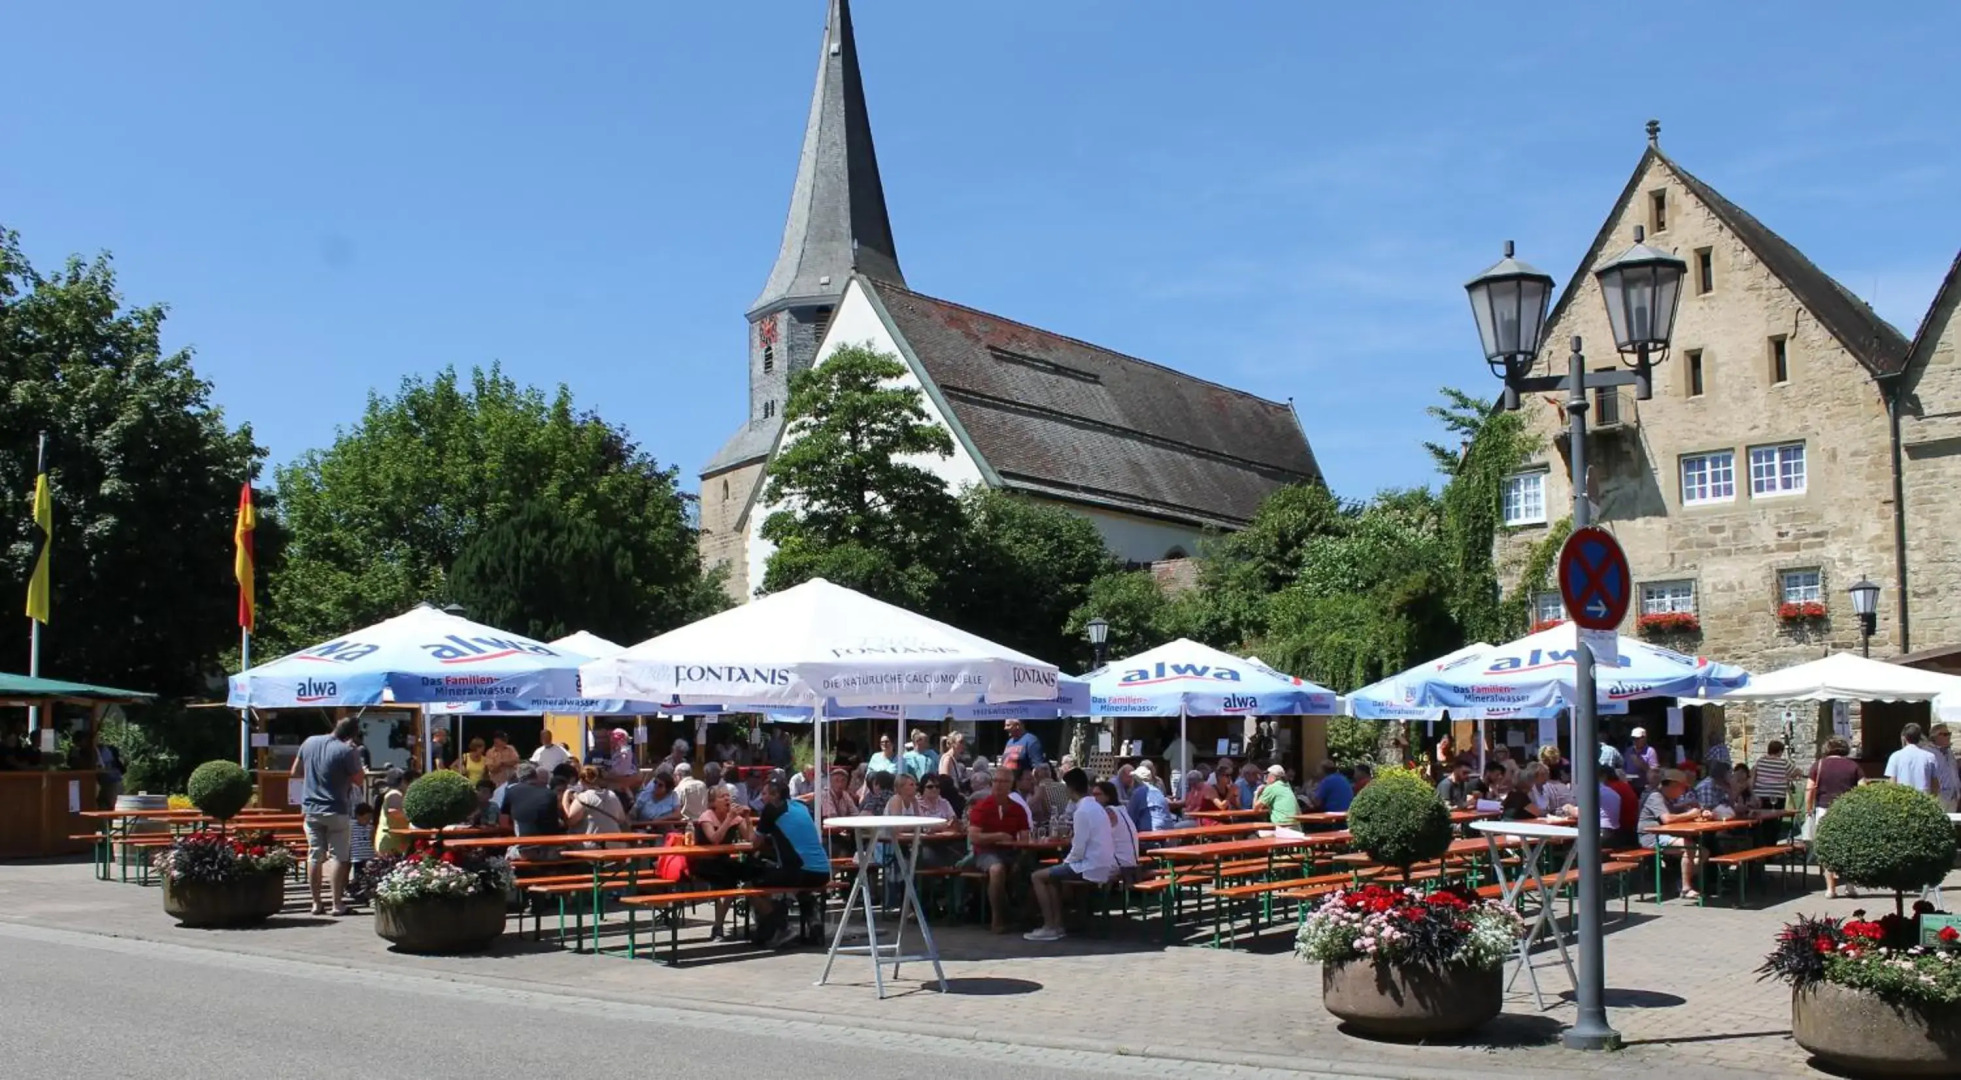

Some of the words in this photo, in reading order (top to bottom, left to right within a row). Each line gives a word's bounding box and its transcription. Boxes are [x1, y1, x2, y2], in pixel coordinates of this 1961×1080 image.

[420, 634, 561, 660] alwa
[675, 665, 789, 687] FONTANIS
[1013, 667, 1056, 688] FONTANIS
[1122, 661, 1241, 682] alwa
[297, 677, 337, 697] alwa
[421, 677, 442, 686] Das
[823, 679, 839, 689] DIE
[843, 672, 902, 687] NATÜRLICHE
[1609, 680, 1652, 695] alwa
[435, 686, 517, 696] Mineralwasser
[1453, 686, 1470, 694] Das
[1223, 693, 1257, 708] alwa
[1464, 693, 1529, 703] Mineralwasser
[1100, 704, 1158, 712] Mineralwasser
